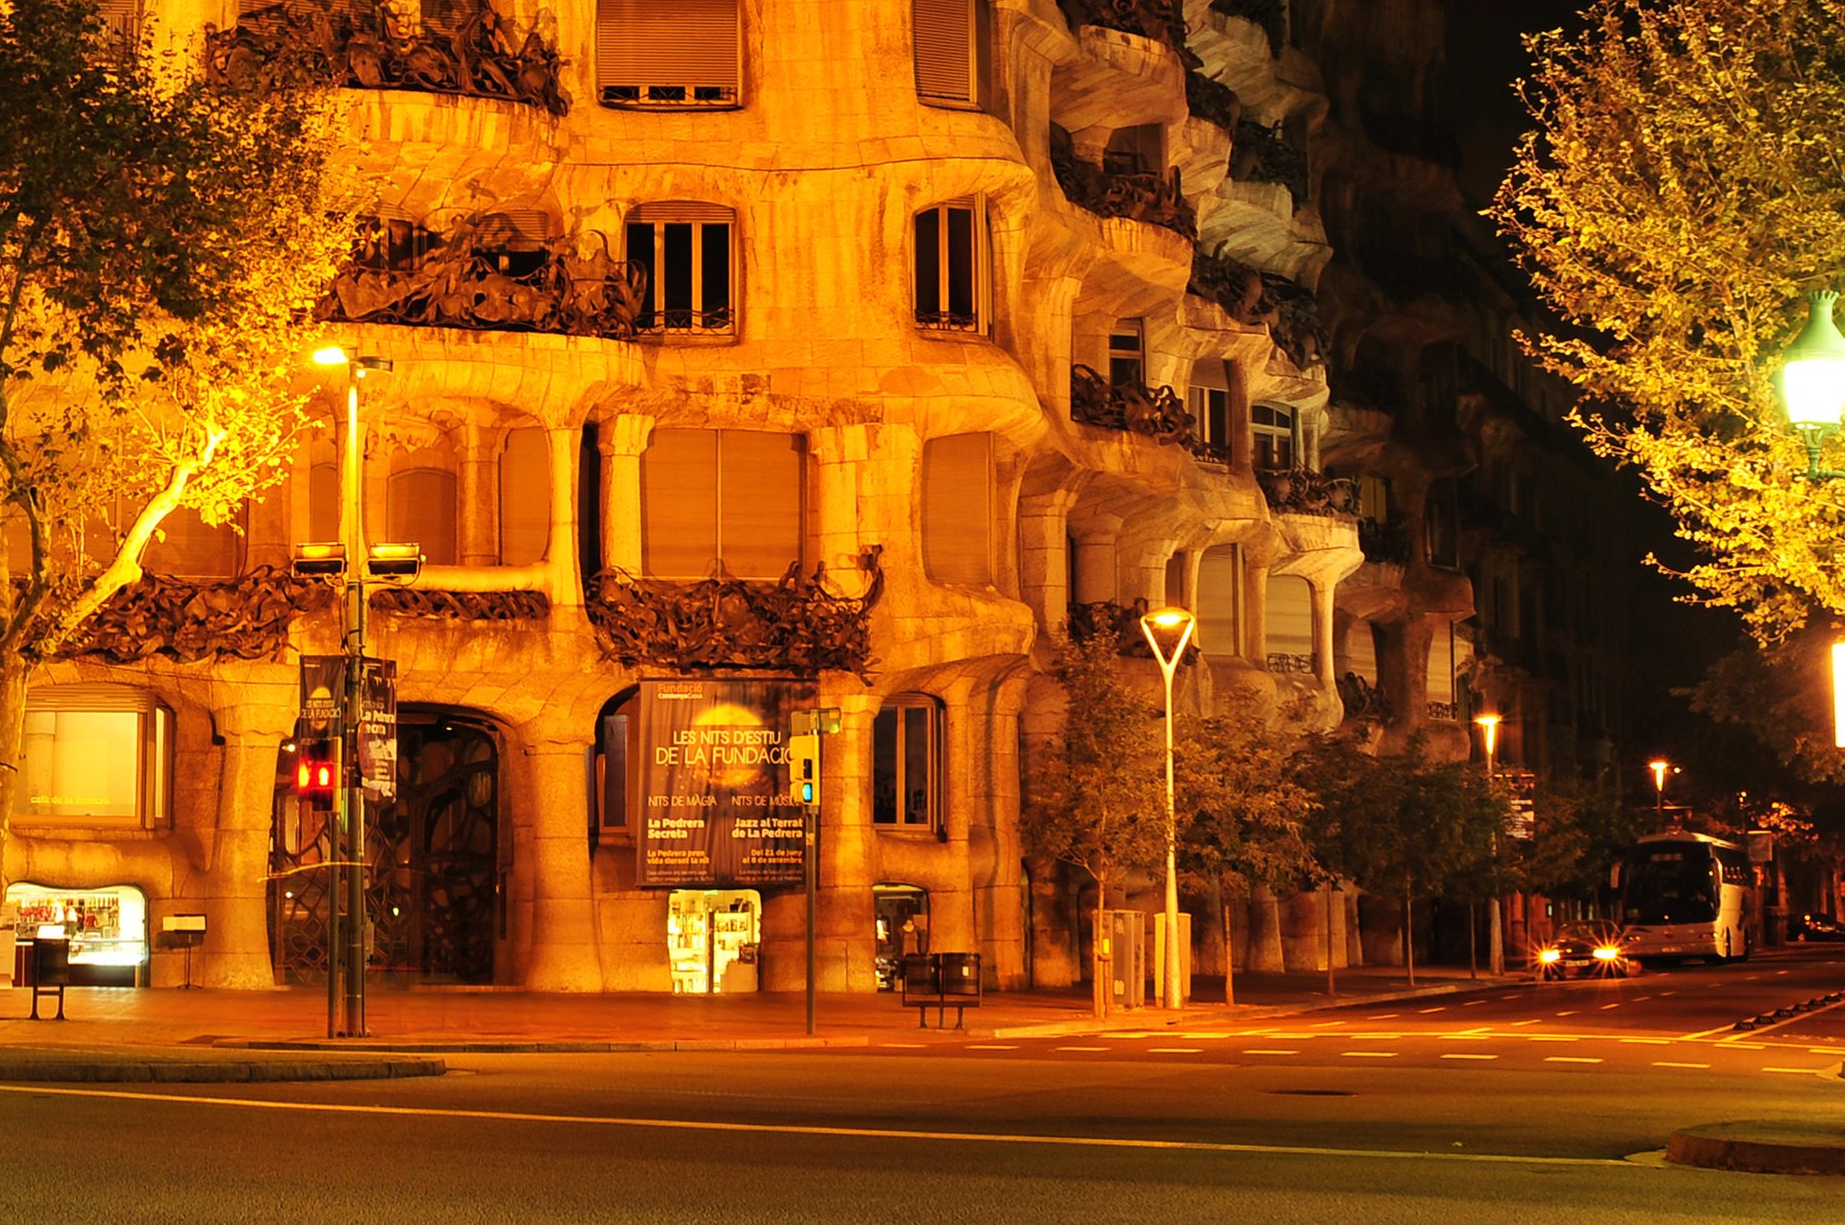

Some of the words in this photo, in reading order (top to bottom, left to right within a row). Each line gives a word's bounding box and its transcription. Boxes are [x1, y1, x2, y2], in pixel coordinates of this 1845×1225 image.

[658, 683, 703, 692] Fundació
[673, 731, 696, 745] LES
[700, 731, 730, 745] NITS
[733, 731, 781, 745] D'ESTIU
[656, 748, 678, 765] DE
[685, 748, 707, 765] LA
[648, 796, 669, 807] NITS
[671, 796, 684, 806] DE
[686, 794, 717, 807] MÀGIA
[731, 796, 752, 806] NITS
[754, 796, 767, 806] DE
[648, 818, 660, 828] La
[663, 818, 705, 828] Pedrera
[735, 818, 759, 828] Jazz
[760, 818, 771, 828] al
[772, 818, 803, 828] Terrat
[648, 829, 688, 839] Secreta
[732, 828, 745, 838] de
[747, 828, 760, 838] La
[762, 828, 803, 838] Pedrera
[751, 849, 763, 857] Del
[765, 849, 774, 857] 21
[776, 849, 786, 857] de
